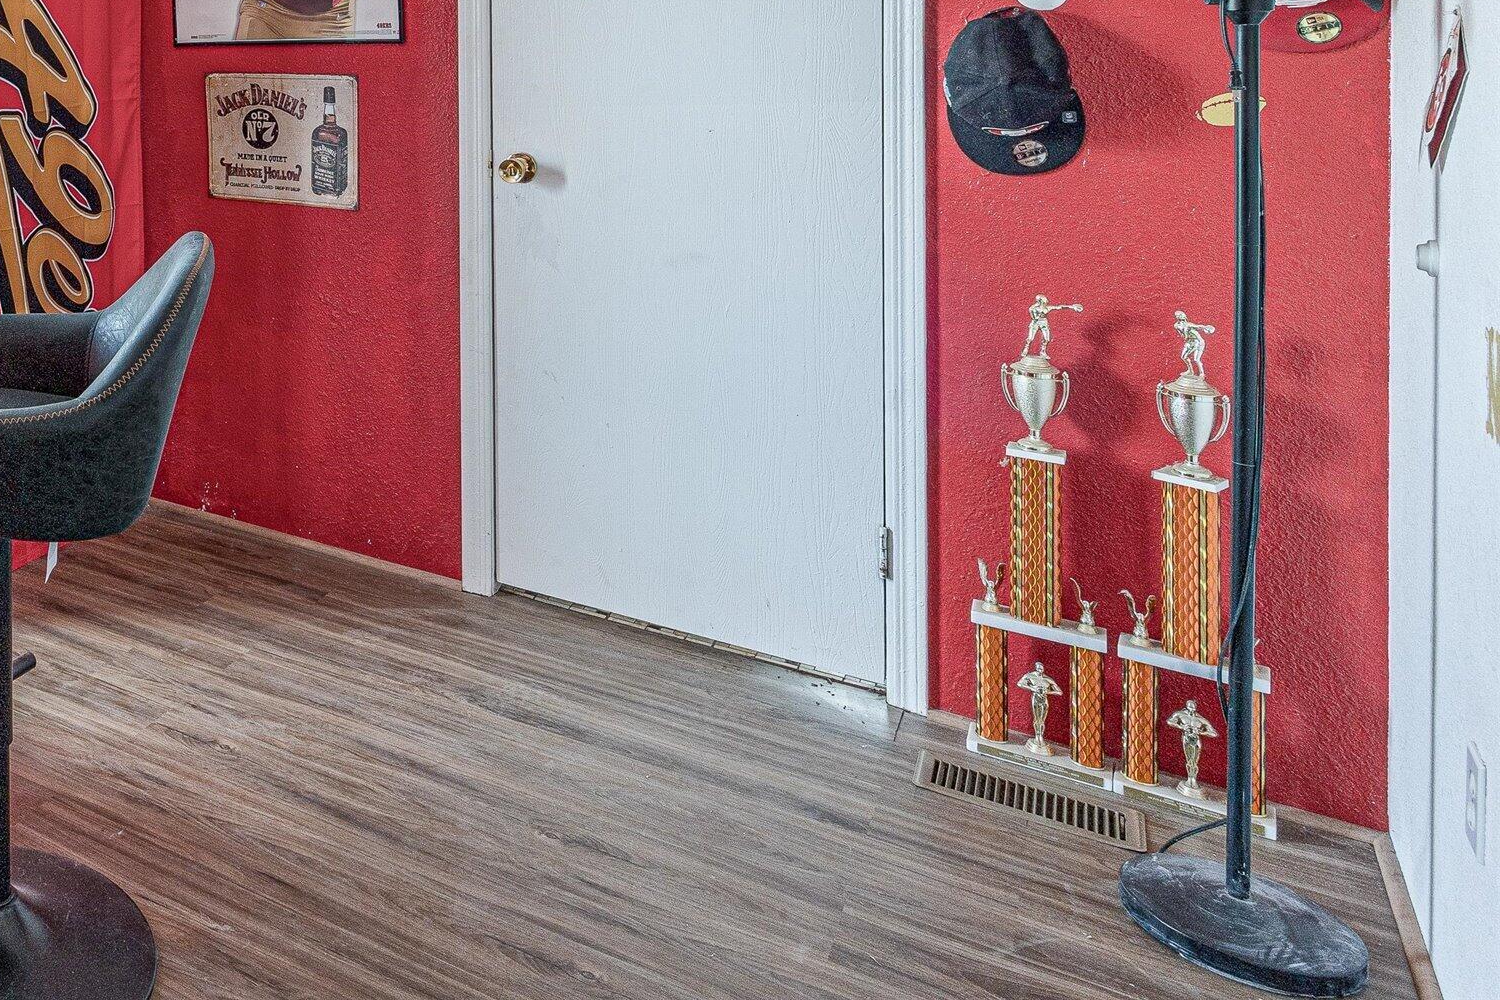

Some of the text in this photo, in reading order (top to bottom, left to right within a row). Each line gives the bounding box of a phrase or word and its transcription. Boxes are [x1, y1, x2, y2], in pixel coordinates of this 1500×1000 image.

[215, 83, 308, 120] JACK DANIEL'S
[269, 155, 287, 163] QUIET
